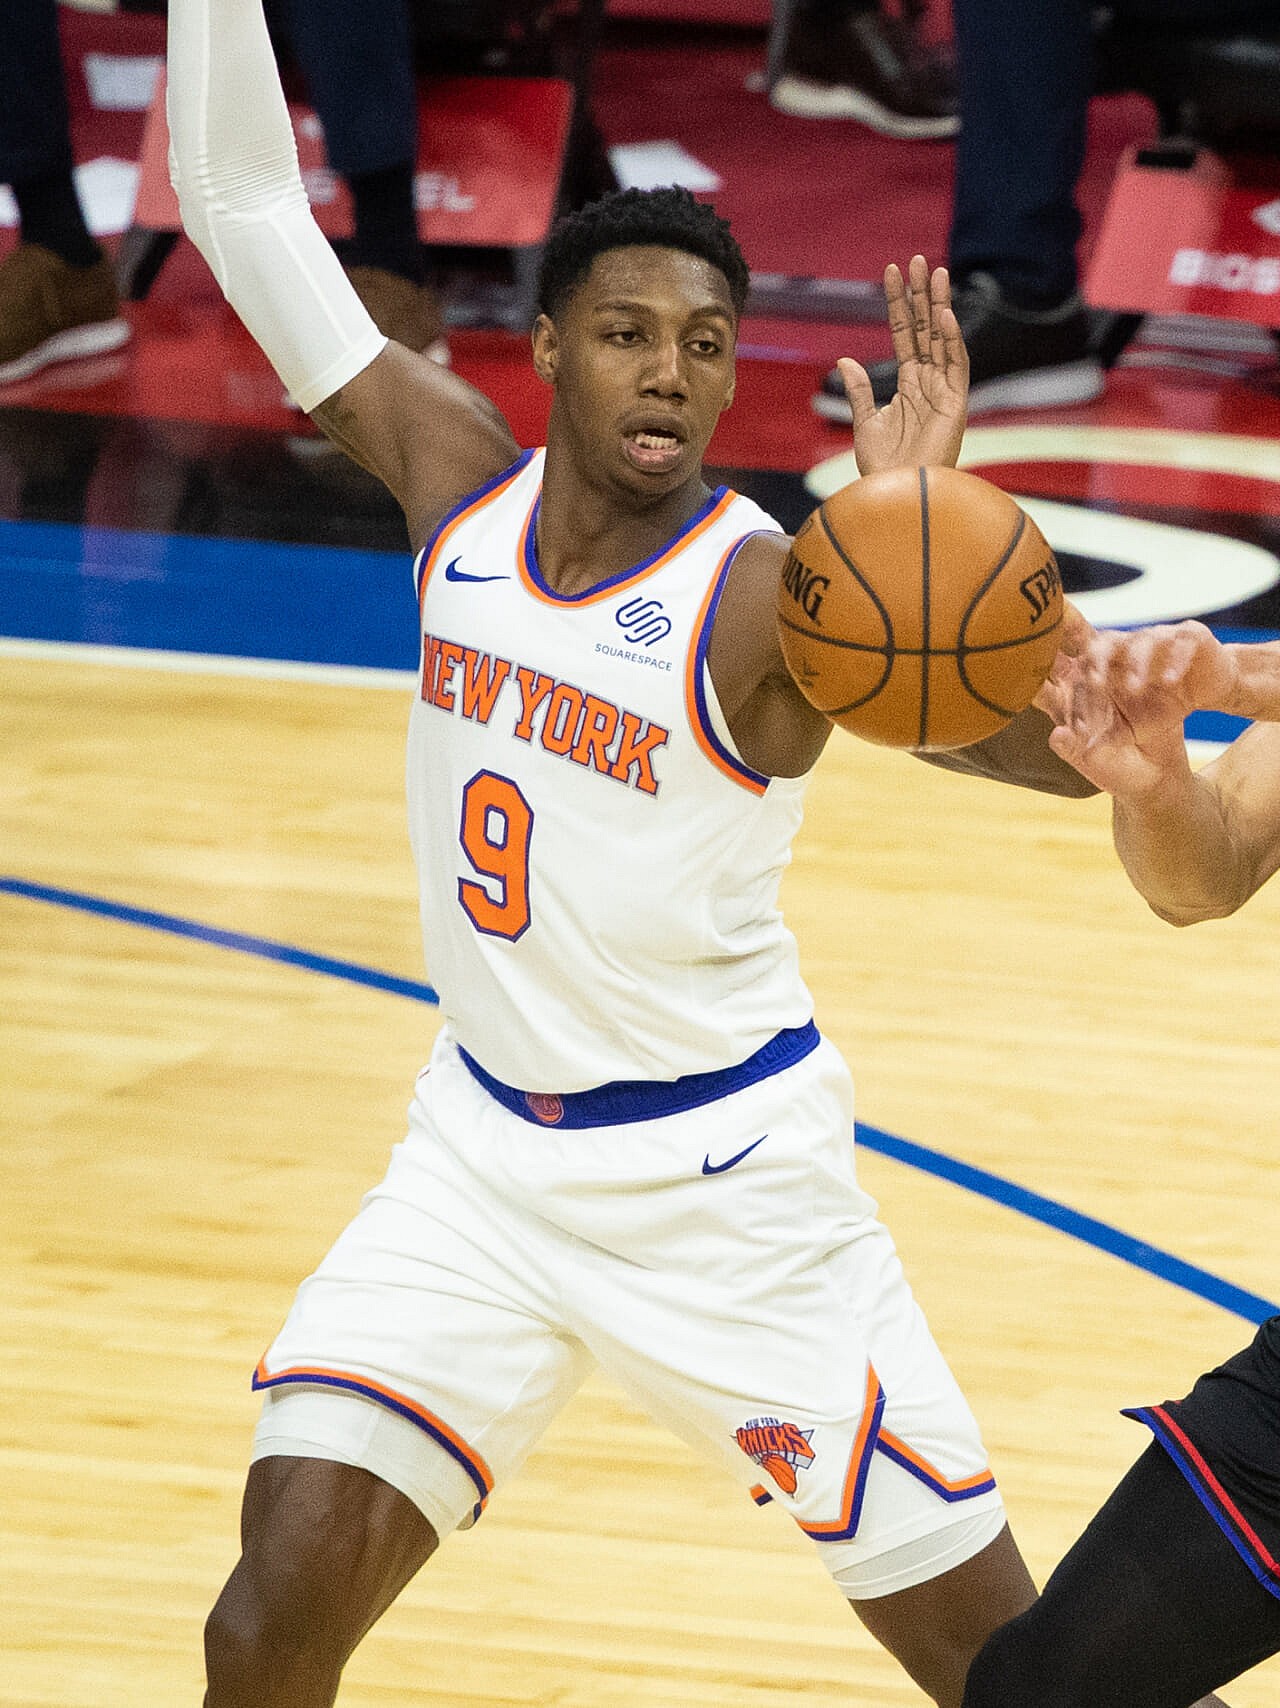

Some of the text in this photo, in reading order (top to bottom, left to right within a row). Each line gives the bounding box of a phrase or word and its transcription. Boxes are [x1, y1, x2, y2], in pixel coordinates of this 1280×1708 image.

[594, 643, 673, 672] SQUARESPACE
[420, 632, 672, 798] NEW YORK
[457, 768, 534, 943] 9
[735, 1422, 816, 1460] KNICKS
